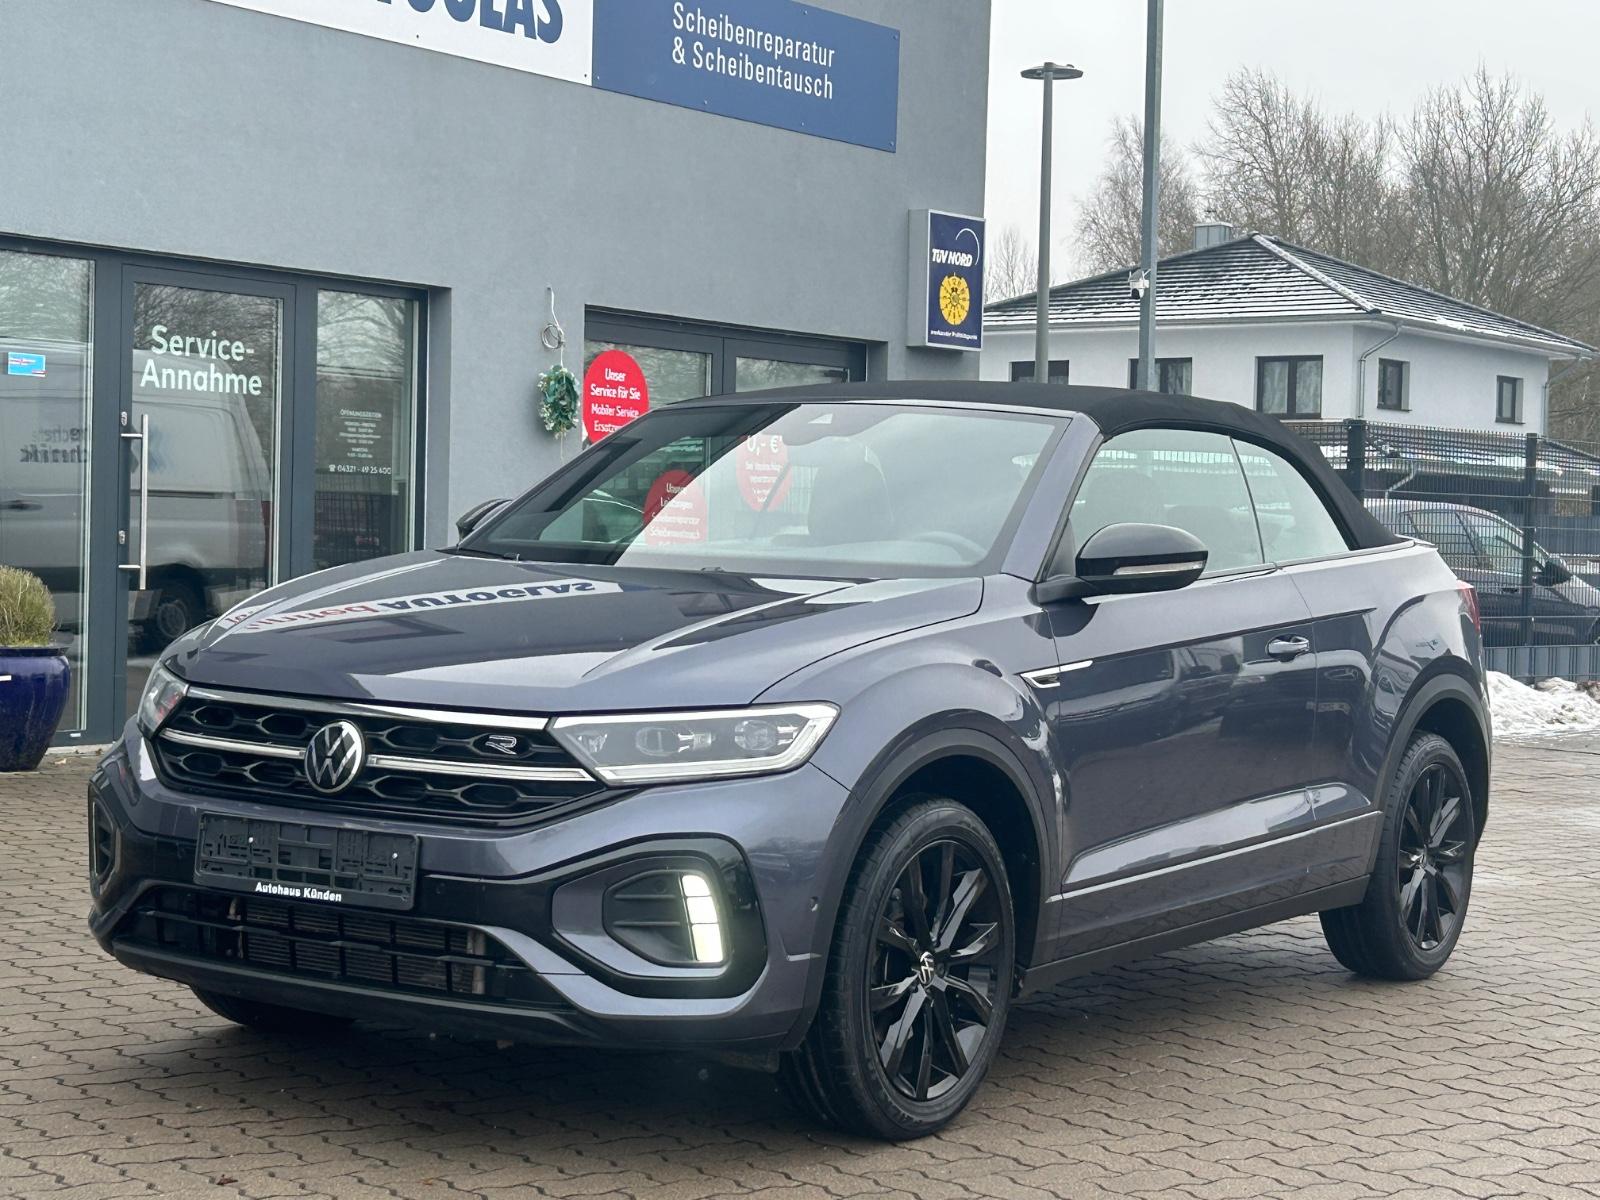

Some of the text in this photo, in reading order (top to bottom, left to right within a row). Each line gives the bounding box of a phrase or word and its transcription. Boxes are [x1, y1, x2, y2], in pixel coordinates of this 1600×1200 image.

[673, 2, 835, 68] Scheibenreparatur
[672, 36, 833, 100] & Scheibentausch
[932, 249, 973, 267] TÜV NORD
[151, 324, 255, 361] Service-
[140, 358, 263, 395] Annahme
[605, 368, 626, 381] Unser
[590, 384, 641, 400] Service für Sie
[591, 403, 640, 418] Mobiler Service
[255, 882, 342, 902] Autohaus Künden
